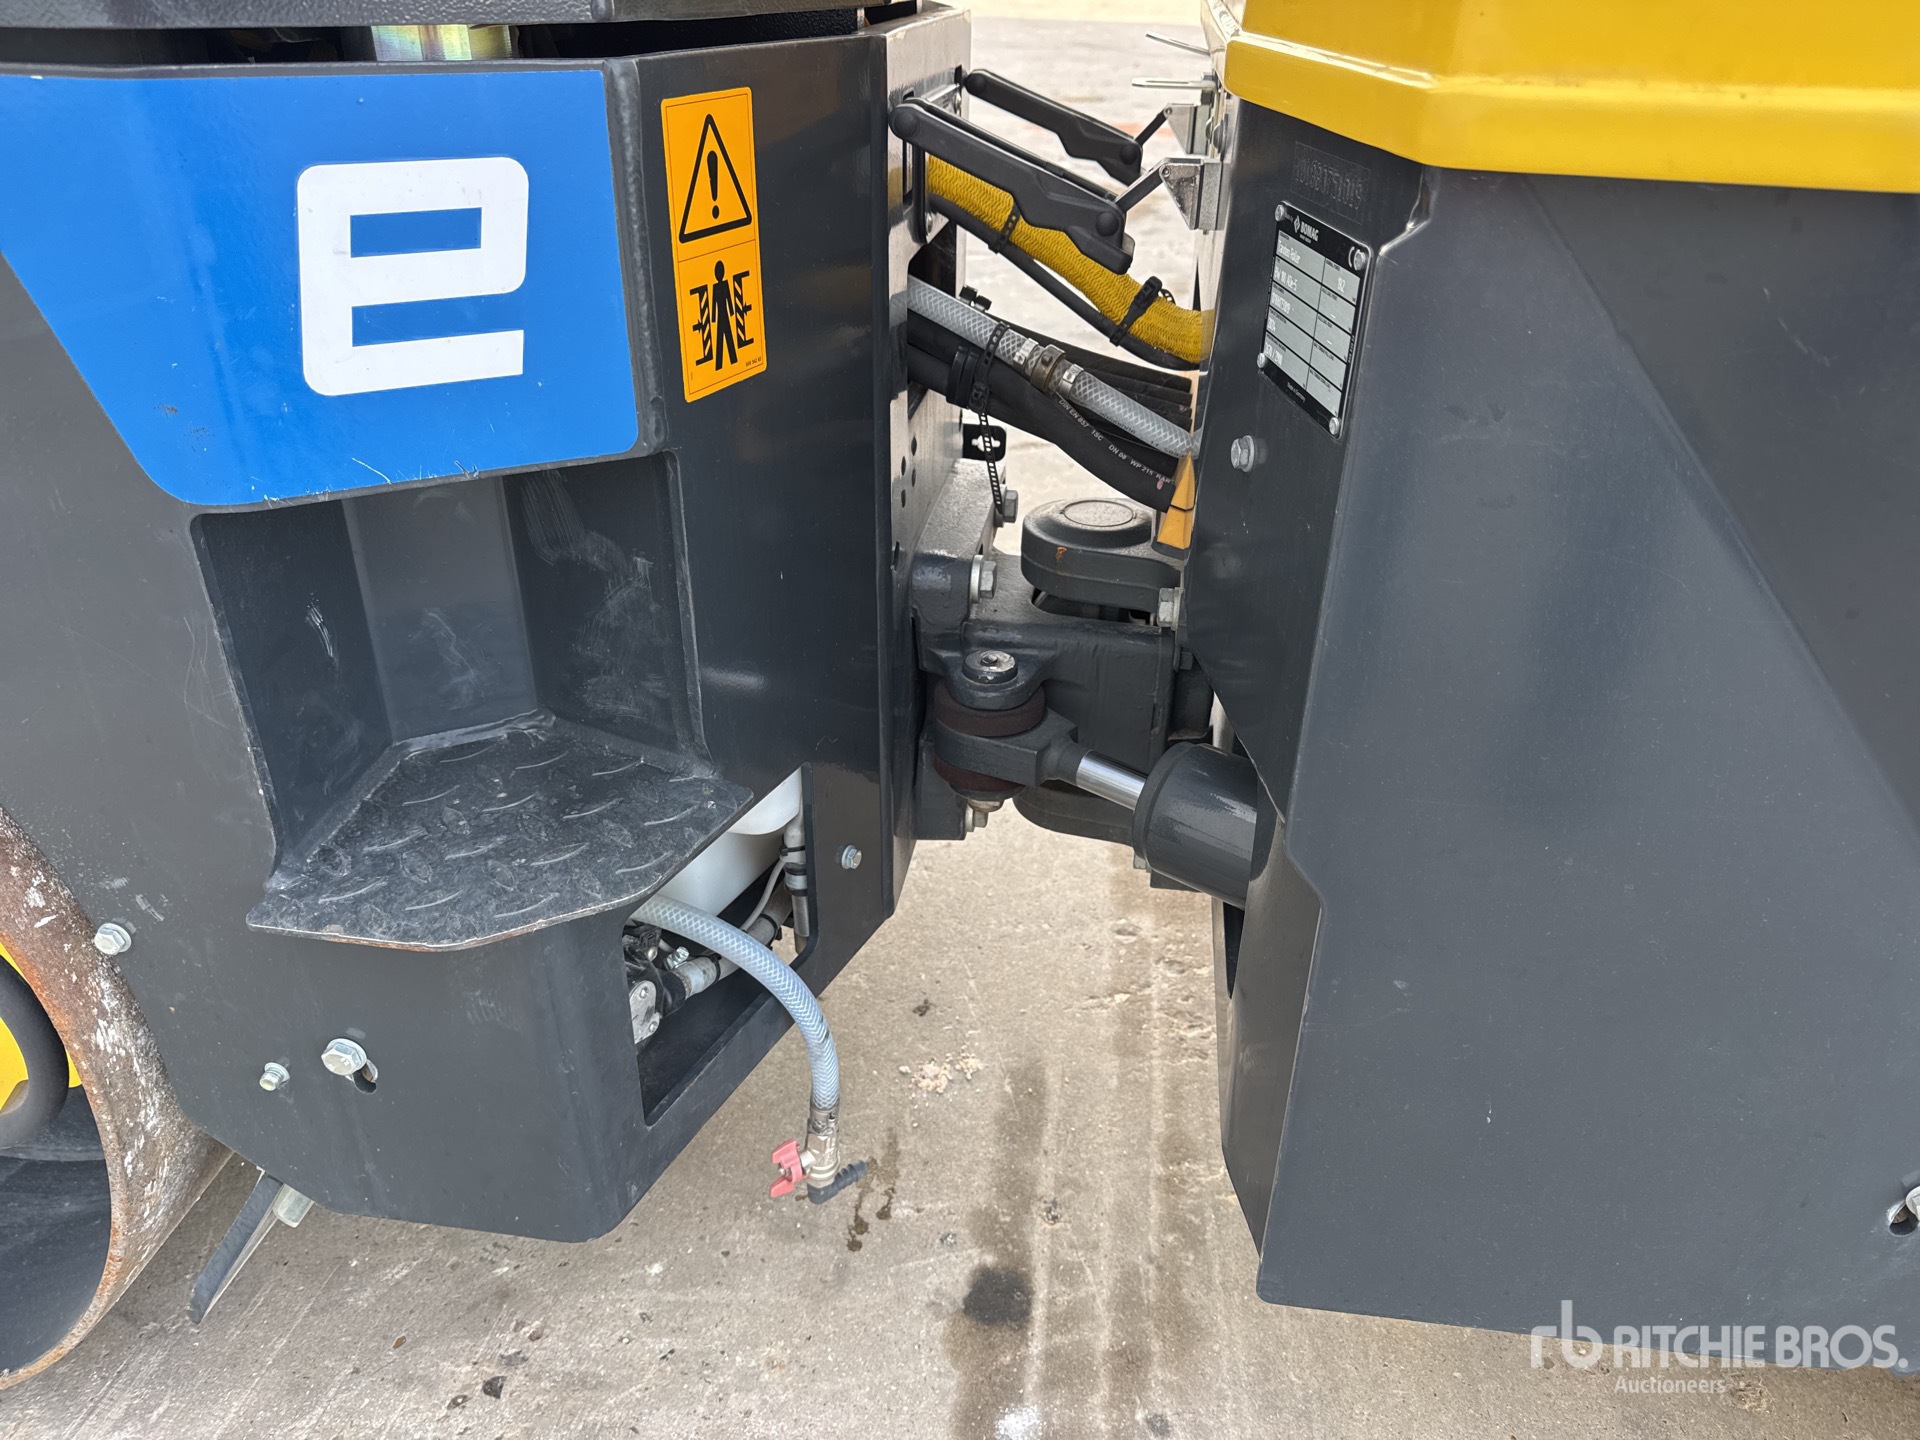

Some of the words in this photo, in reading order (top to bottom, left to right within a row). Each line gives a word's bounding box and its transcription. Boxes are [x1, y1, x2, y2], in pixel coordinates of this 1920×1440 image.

[1300, 221, 1319, 242] BOMAG
[298, 157, 529, 396] e
[1059, 399, 1070, 411] DIN
[1069, 408, 1079, 419] EN
[1091, 429, 1104, 441] 1SC
[1108, 444, 1119, 455] DN
[1130, 459, 1141, 469] WP
